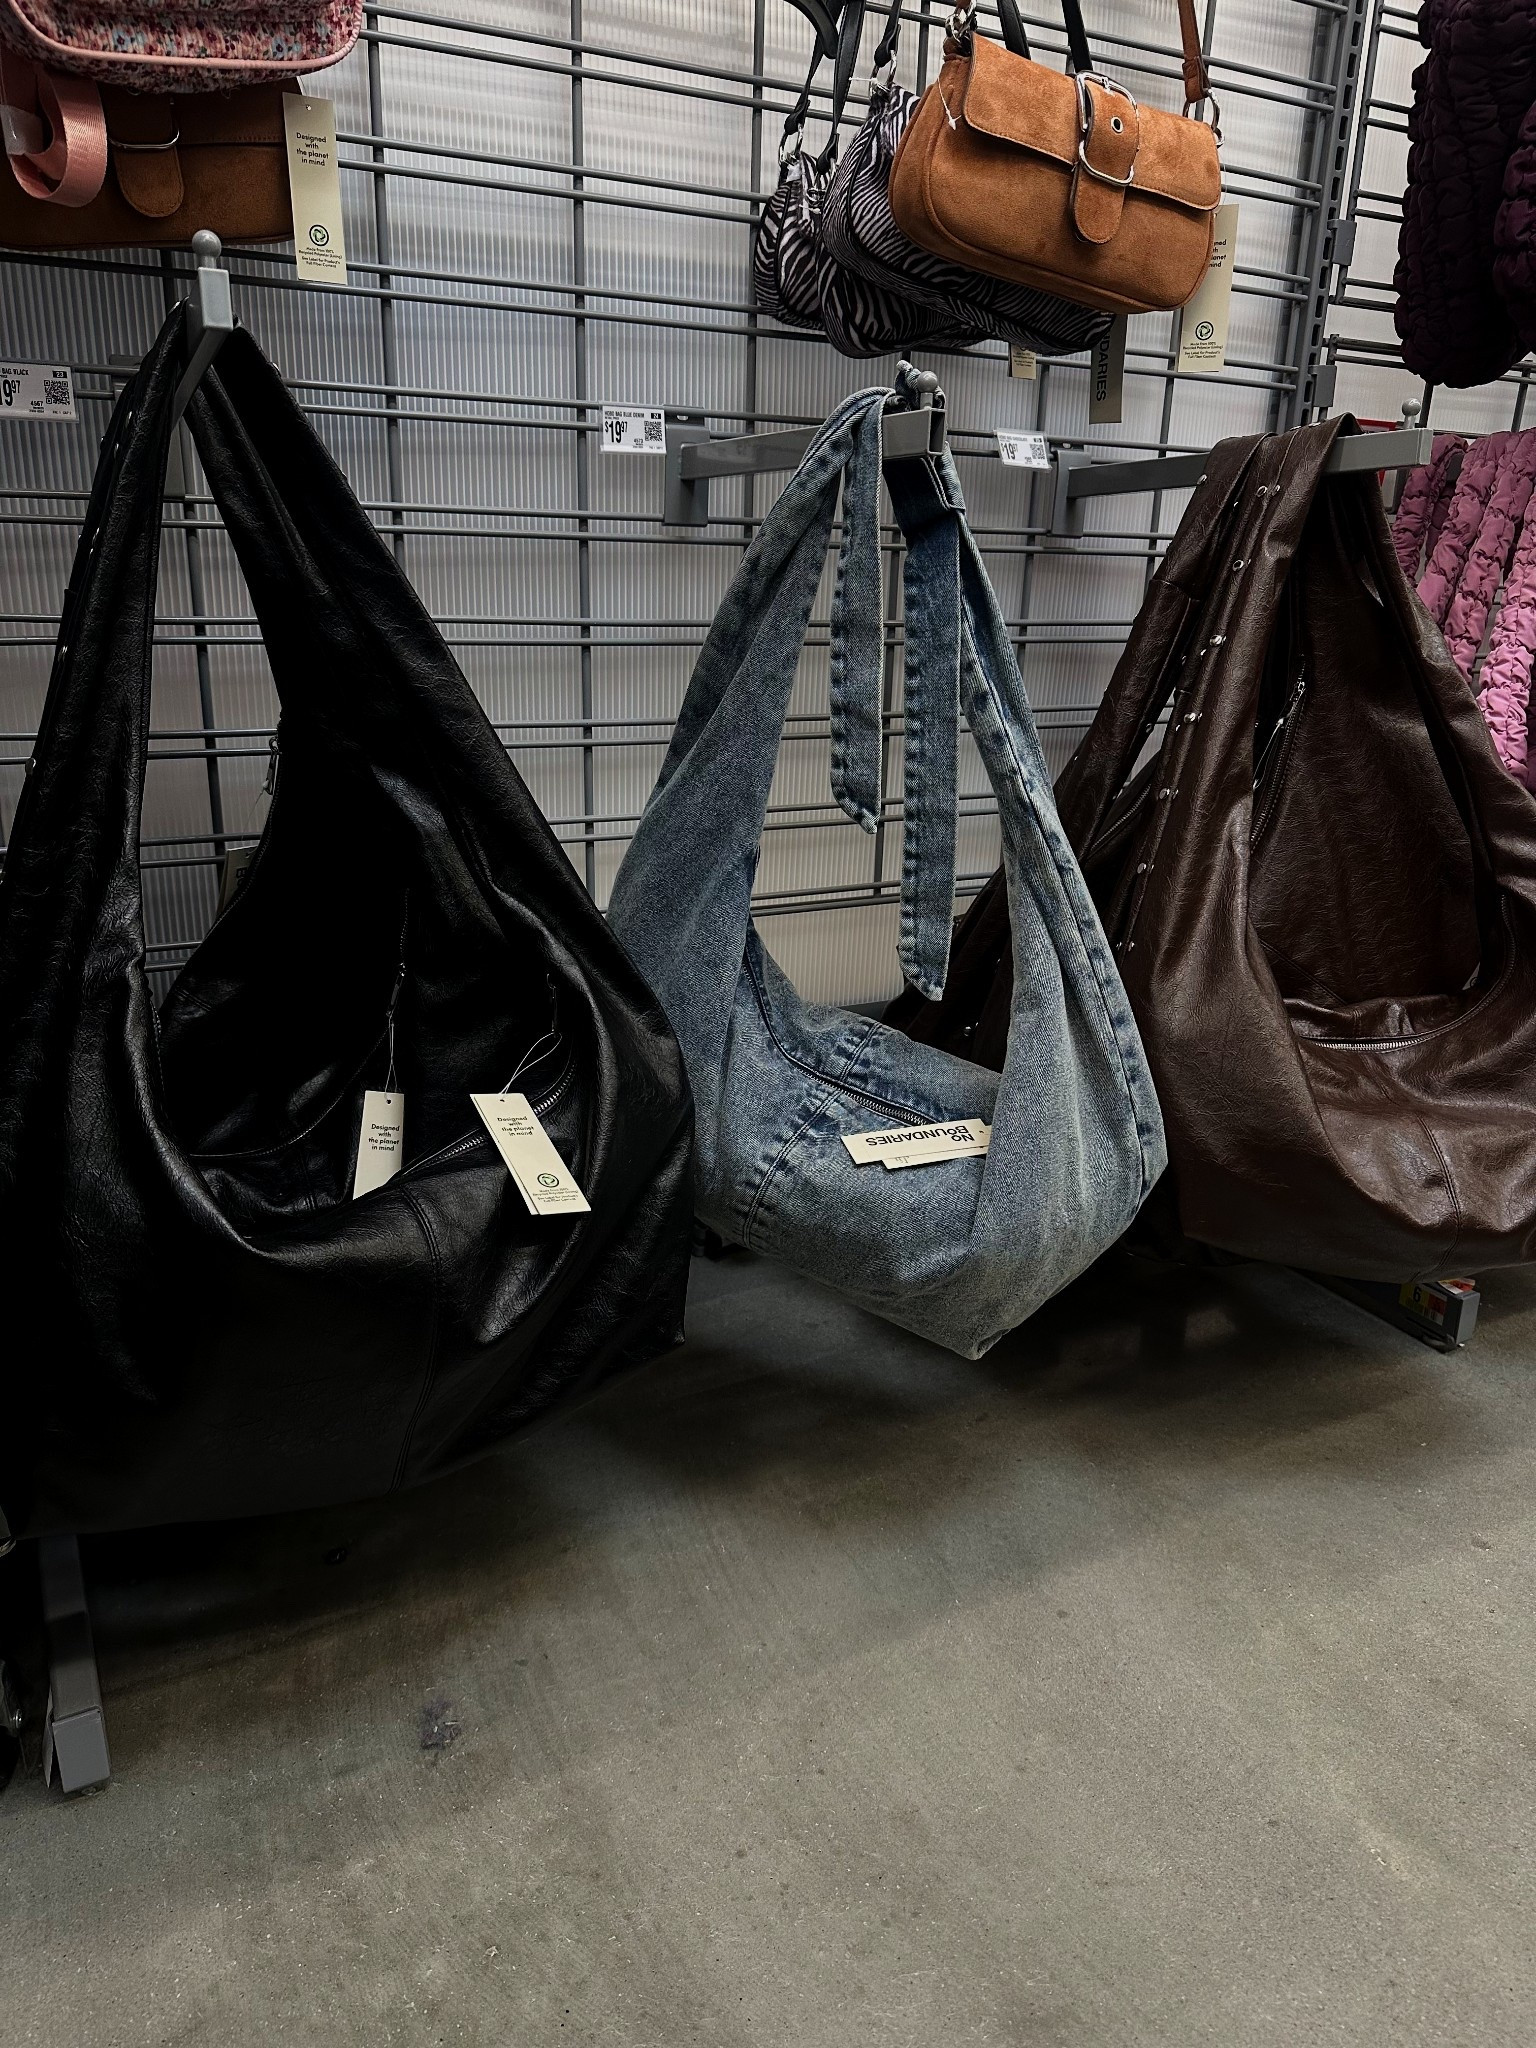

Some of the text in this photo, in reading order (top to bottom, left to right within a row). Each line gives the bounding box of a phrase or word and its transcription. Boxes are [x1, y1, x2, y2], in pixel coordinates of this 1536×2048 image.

[296, 132, 327, 143] Designed
[296, 148, 329, 159] the planet
[301, 156, 308, 164] in
[371, 1123, 400, 1132] Designed
